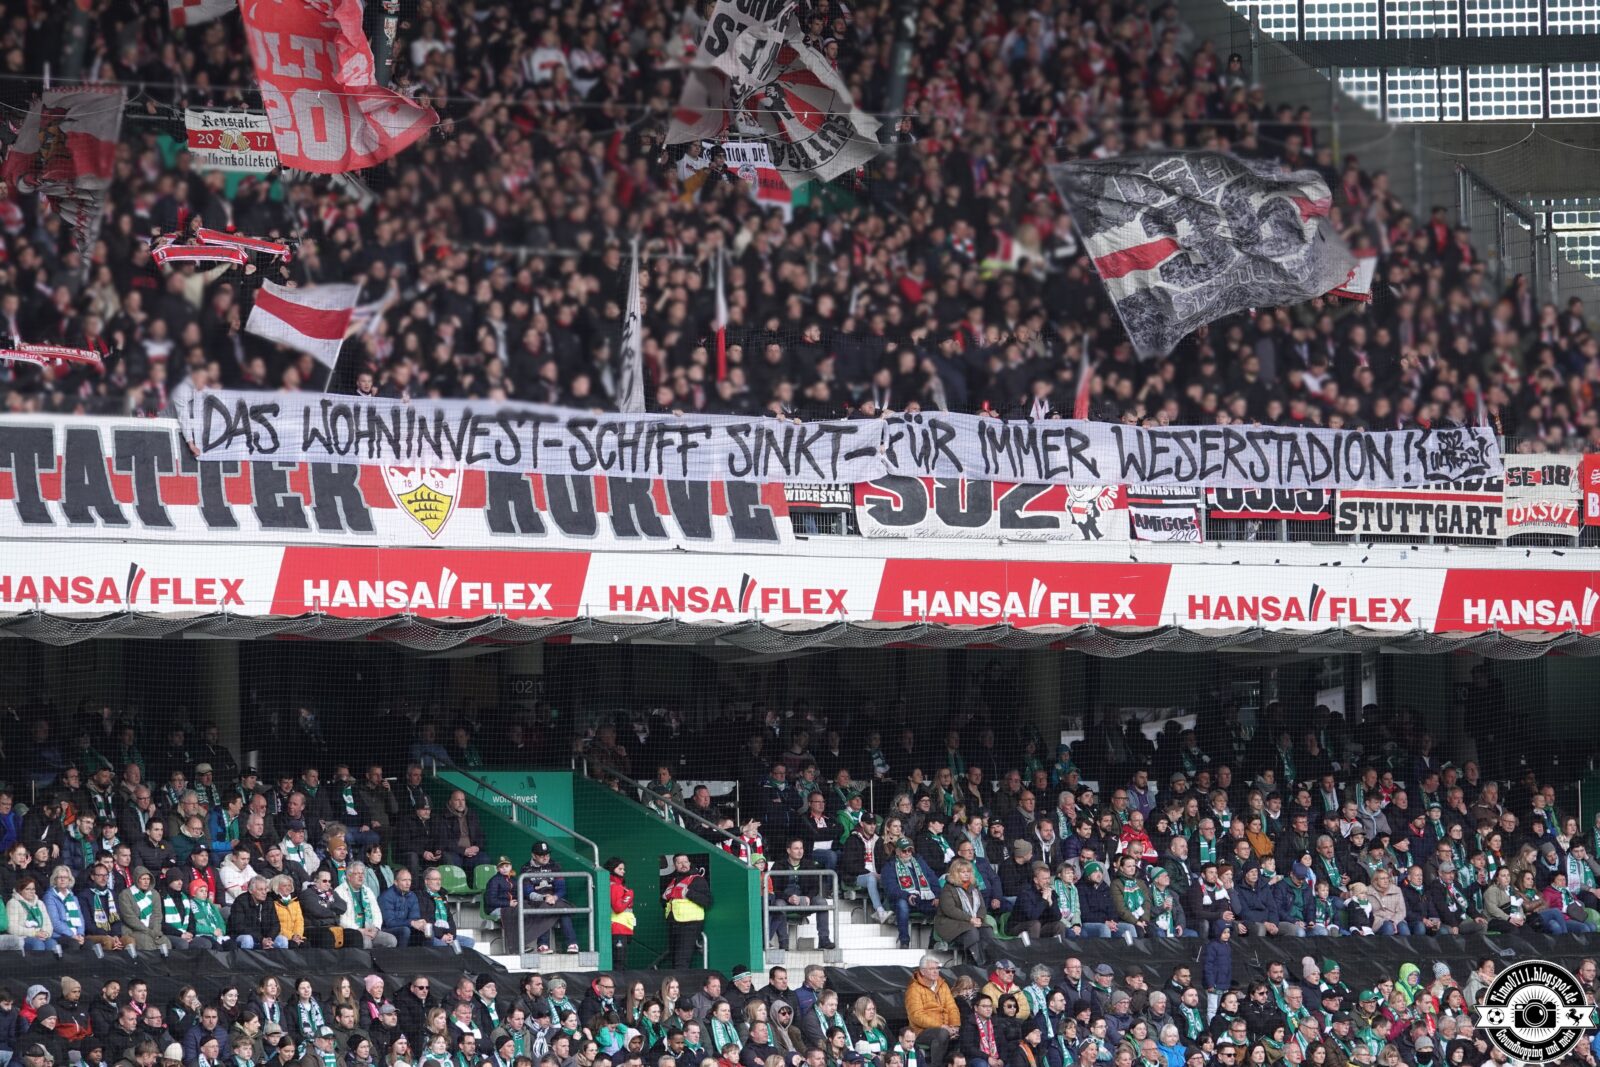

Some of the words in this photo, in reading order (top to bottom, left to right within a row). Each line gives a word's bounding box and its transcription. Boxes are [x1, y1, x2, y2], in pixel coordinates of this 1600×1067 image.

[197, 133, 214, 144] 20
[256, 135, 267, 147] 17
[202, 394, 280, 454] DAS
[301, 398, 714, 477] WOHNINVEST-SCHIFF
[884, 414, 963, 474] FÜR
[978, 418, 1099, 480] IMMER
[1507, 466, 1536, 486] SE
[1541, 465, 1571, 485] 08
[1338, 501, 1499, 536] STUTTGART
[1168, 530, 1199, 540] 2010
[150, 577, 244, 606] FLEX
[303, 578, 427, 608] HANSA
[460, 581, 551, 610] FLEX
[608, 584, 727, 612] HANSA
[759, 587, 847, 614] FLEX
[903, 589, 1019, 616] HANSA
[1049, 591, 1136, 618] FLEX
[1187, 595, 1300, 621] HANSA
[1330, 597, 1413, 623] FLEX
[1463, 598, 1577, 625] HANSA
